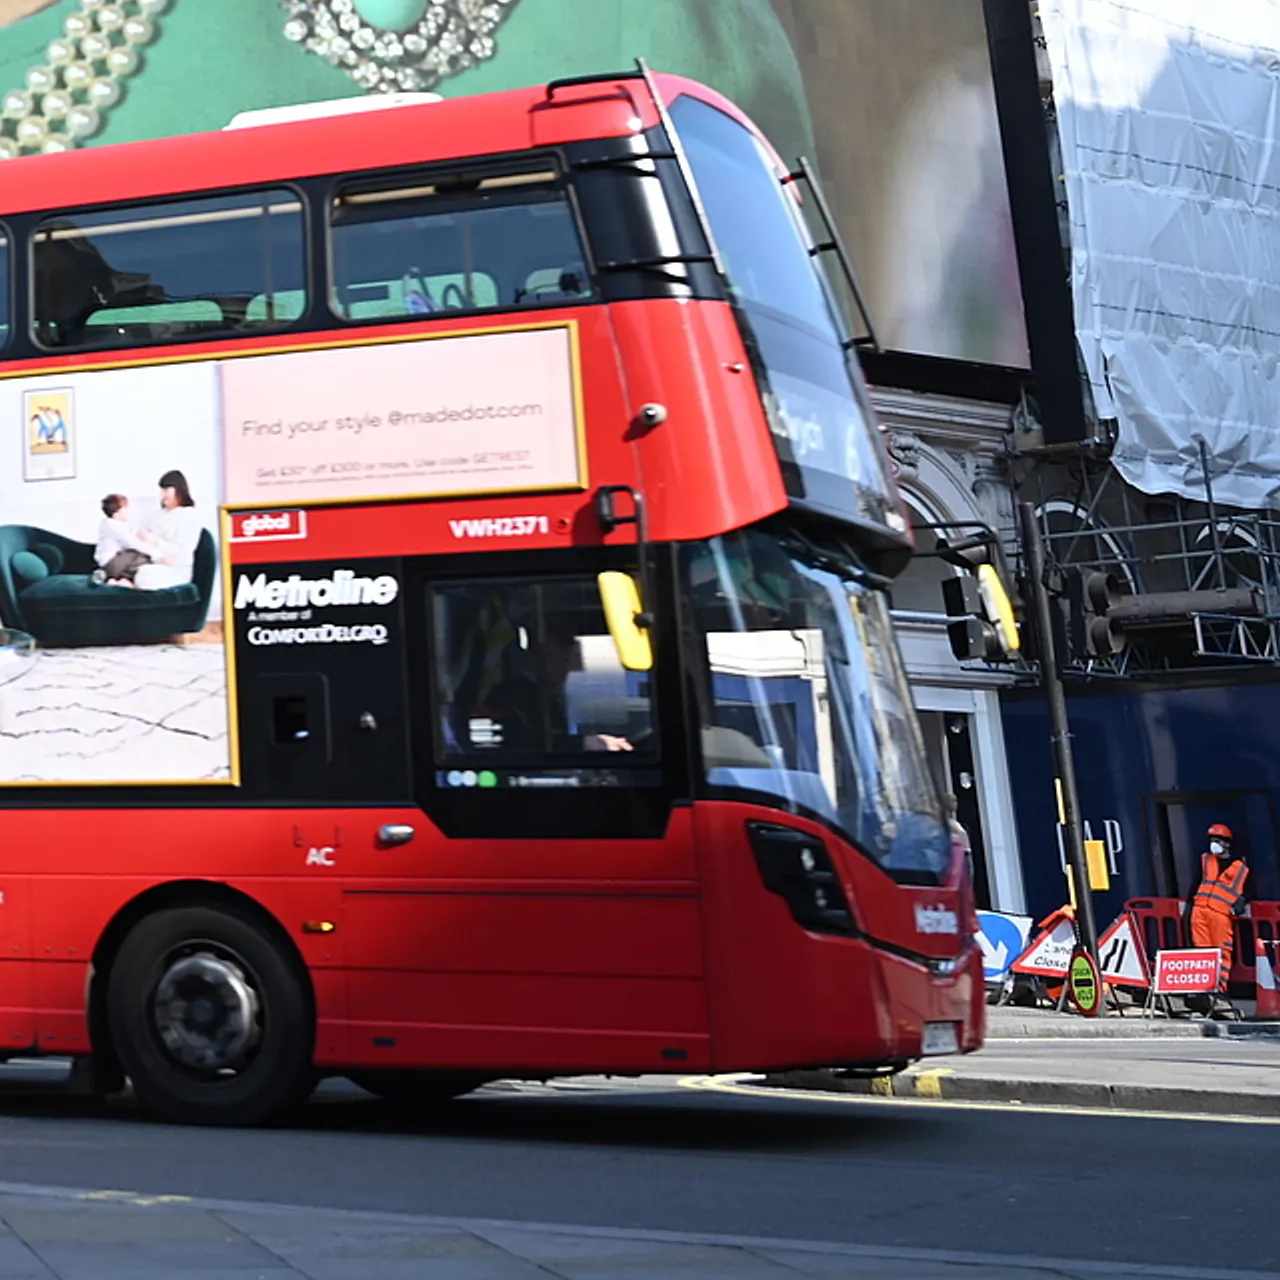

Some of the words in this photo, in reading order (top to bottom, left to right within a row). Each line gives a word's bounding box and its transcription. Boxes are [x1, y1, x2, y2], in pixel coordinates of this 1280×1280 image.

[242, 419, 283, 436] Find
[288, 419, 329, 439] your
[335, 413, 382, 435] style
[387, 402, 543, 427] @madedotcom
[241, 513, 290, 536] global
[448, 516, 549, 539] VWH2371
[234, 570, 399, 609] Metroline
[306, 847, 335, 866] AC
[1034, 955, 1068, 970] Close
[1162, 959, 1216, 971] FOOTPATH
[1166, 973, 1210, 985] CLOSED
